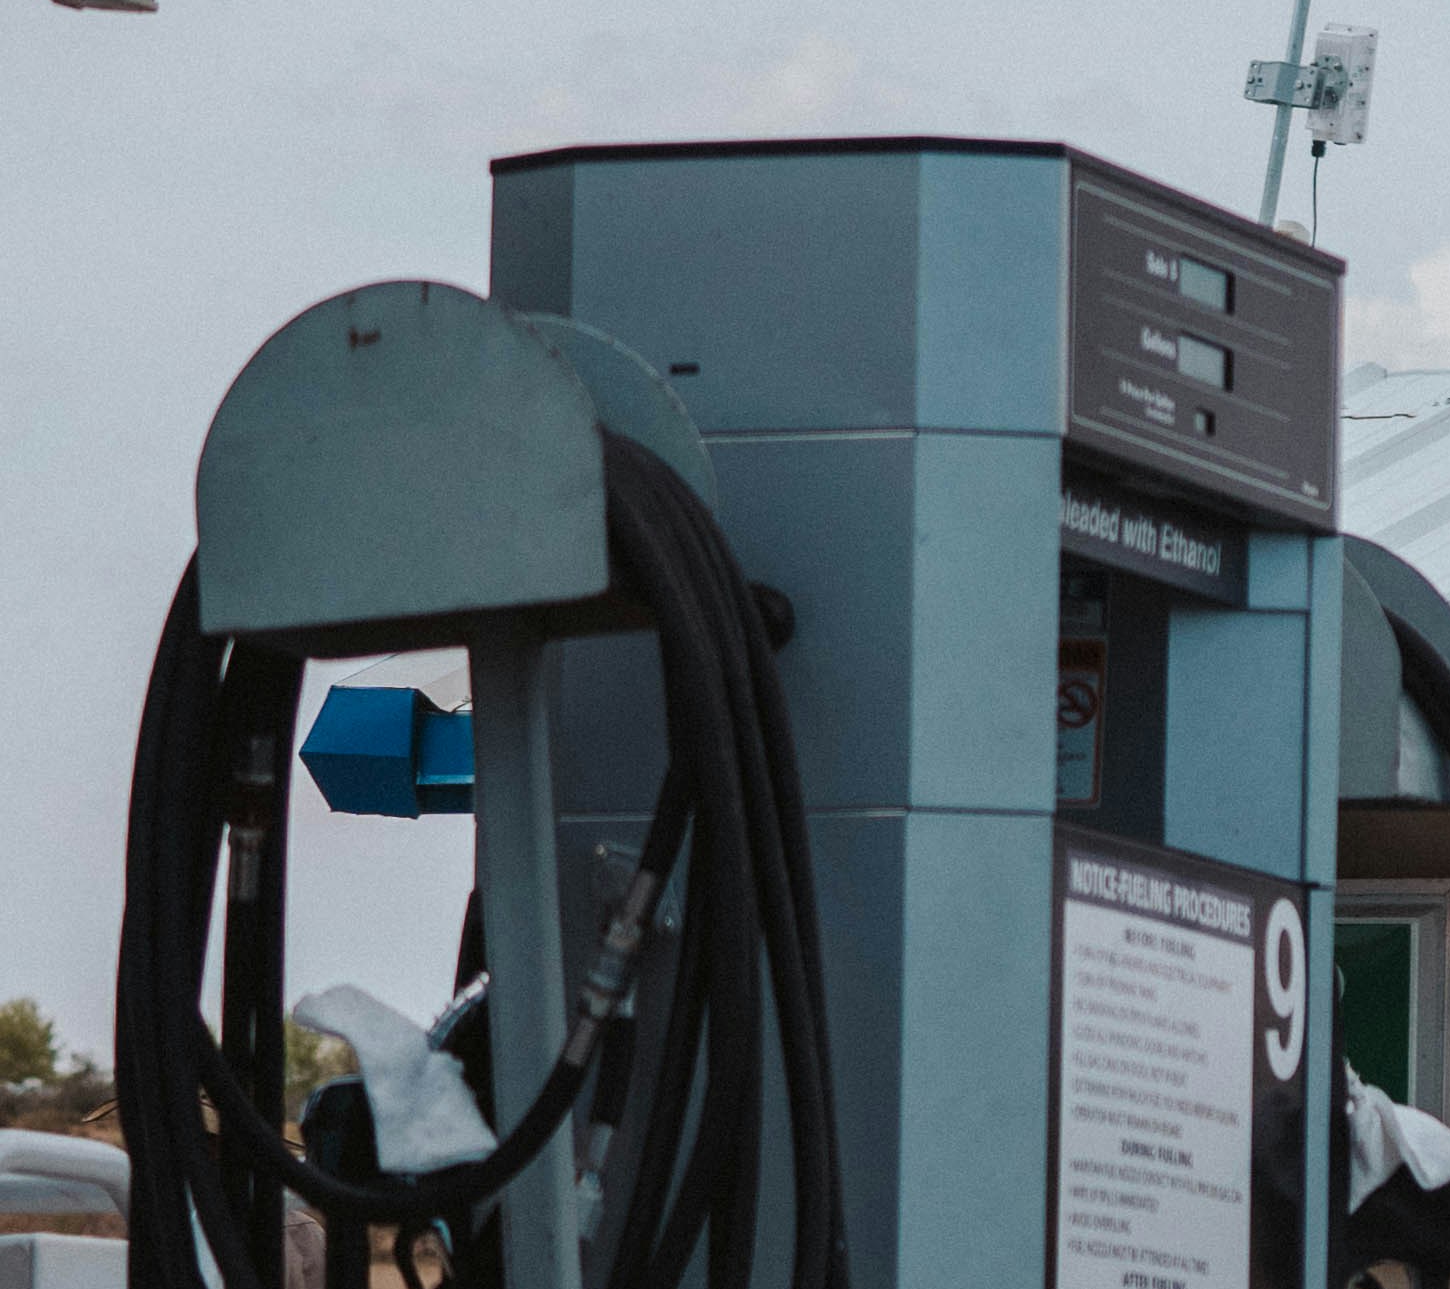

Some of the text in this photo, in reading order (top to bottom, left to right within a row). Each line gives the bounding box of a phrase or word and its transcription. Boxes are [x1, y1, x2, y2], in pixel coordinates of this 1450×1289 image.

[1122, 515, 1157, 556] with
[1160, 523, 1222, 577] Ethanol
[1174, 885, 1251, 938] PROCEDURES
[1265, 897, 1306, 1081] 9
